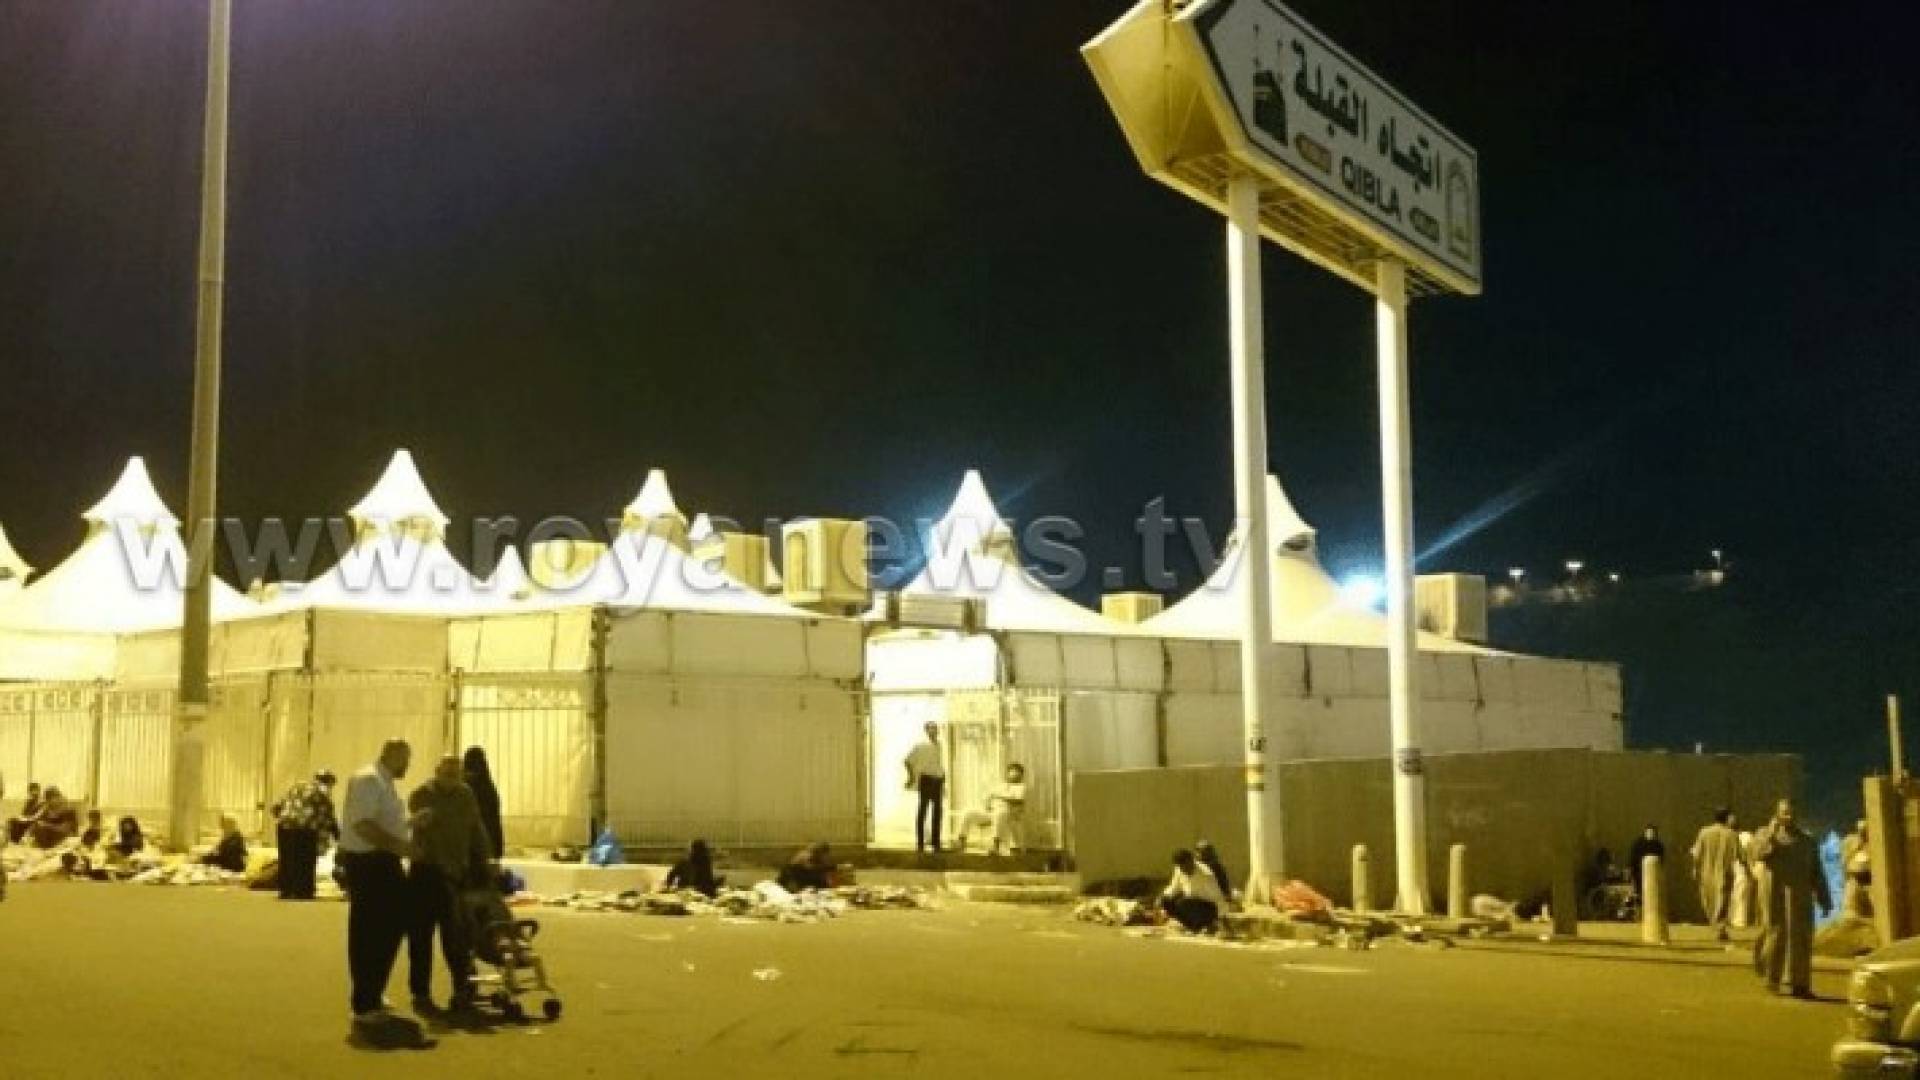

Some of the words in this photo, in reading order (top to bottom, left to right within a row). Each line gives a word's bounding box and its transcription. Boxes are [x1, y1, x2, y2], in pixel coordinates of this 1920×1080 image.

[1292, 39, 1368, 143] القبلة
[1341, 155, 1401, 222] QIBLA
[1378, 116, 1441, 194] اتجاه
